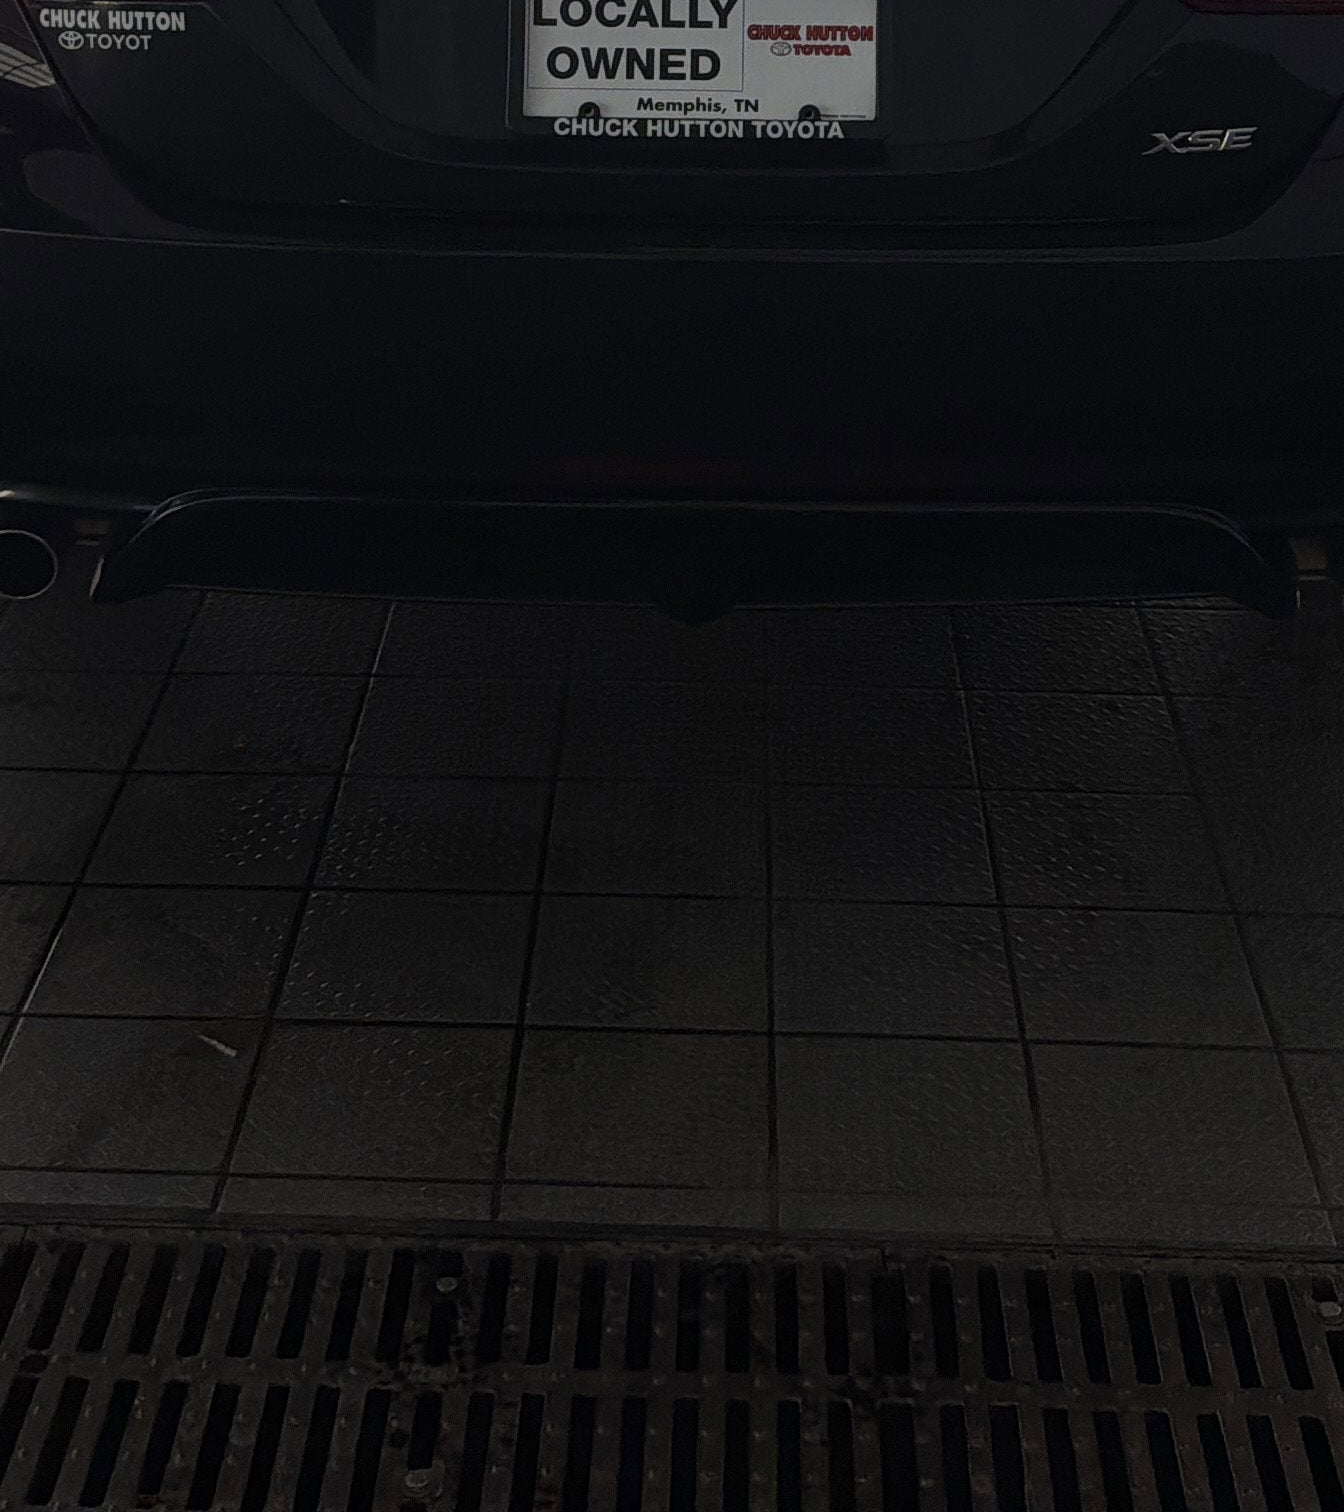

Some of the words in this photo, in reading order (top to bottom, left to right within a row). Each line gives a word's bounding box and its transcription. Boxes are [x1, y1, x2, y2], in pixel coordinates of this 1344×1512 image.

[39, 8, 101, 29] CHUCK
[108, 10, 186, 31] HUTTON
[747, 24, 801, 41] CHUCK
[806, 25, 874, 41] HUTTON
[793, 44, 852, 56] TOYOTA
[546, 46, 721, 80] OWNED
[636, 97, 727, 113] Memphis,
[734, 99, 759, 112] TN
[553, 118, 639, 137] CHUCK
[646, 119, 744, 138] HUTTON
[753, 120, 845, 139] TOYOTA
[1141, 126, 1259, 156] XSE
